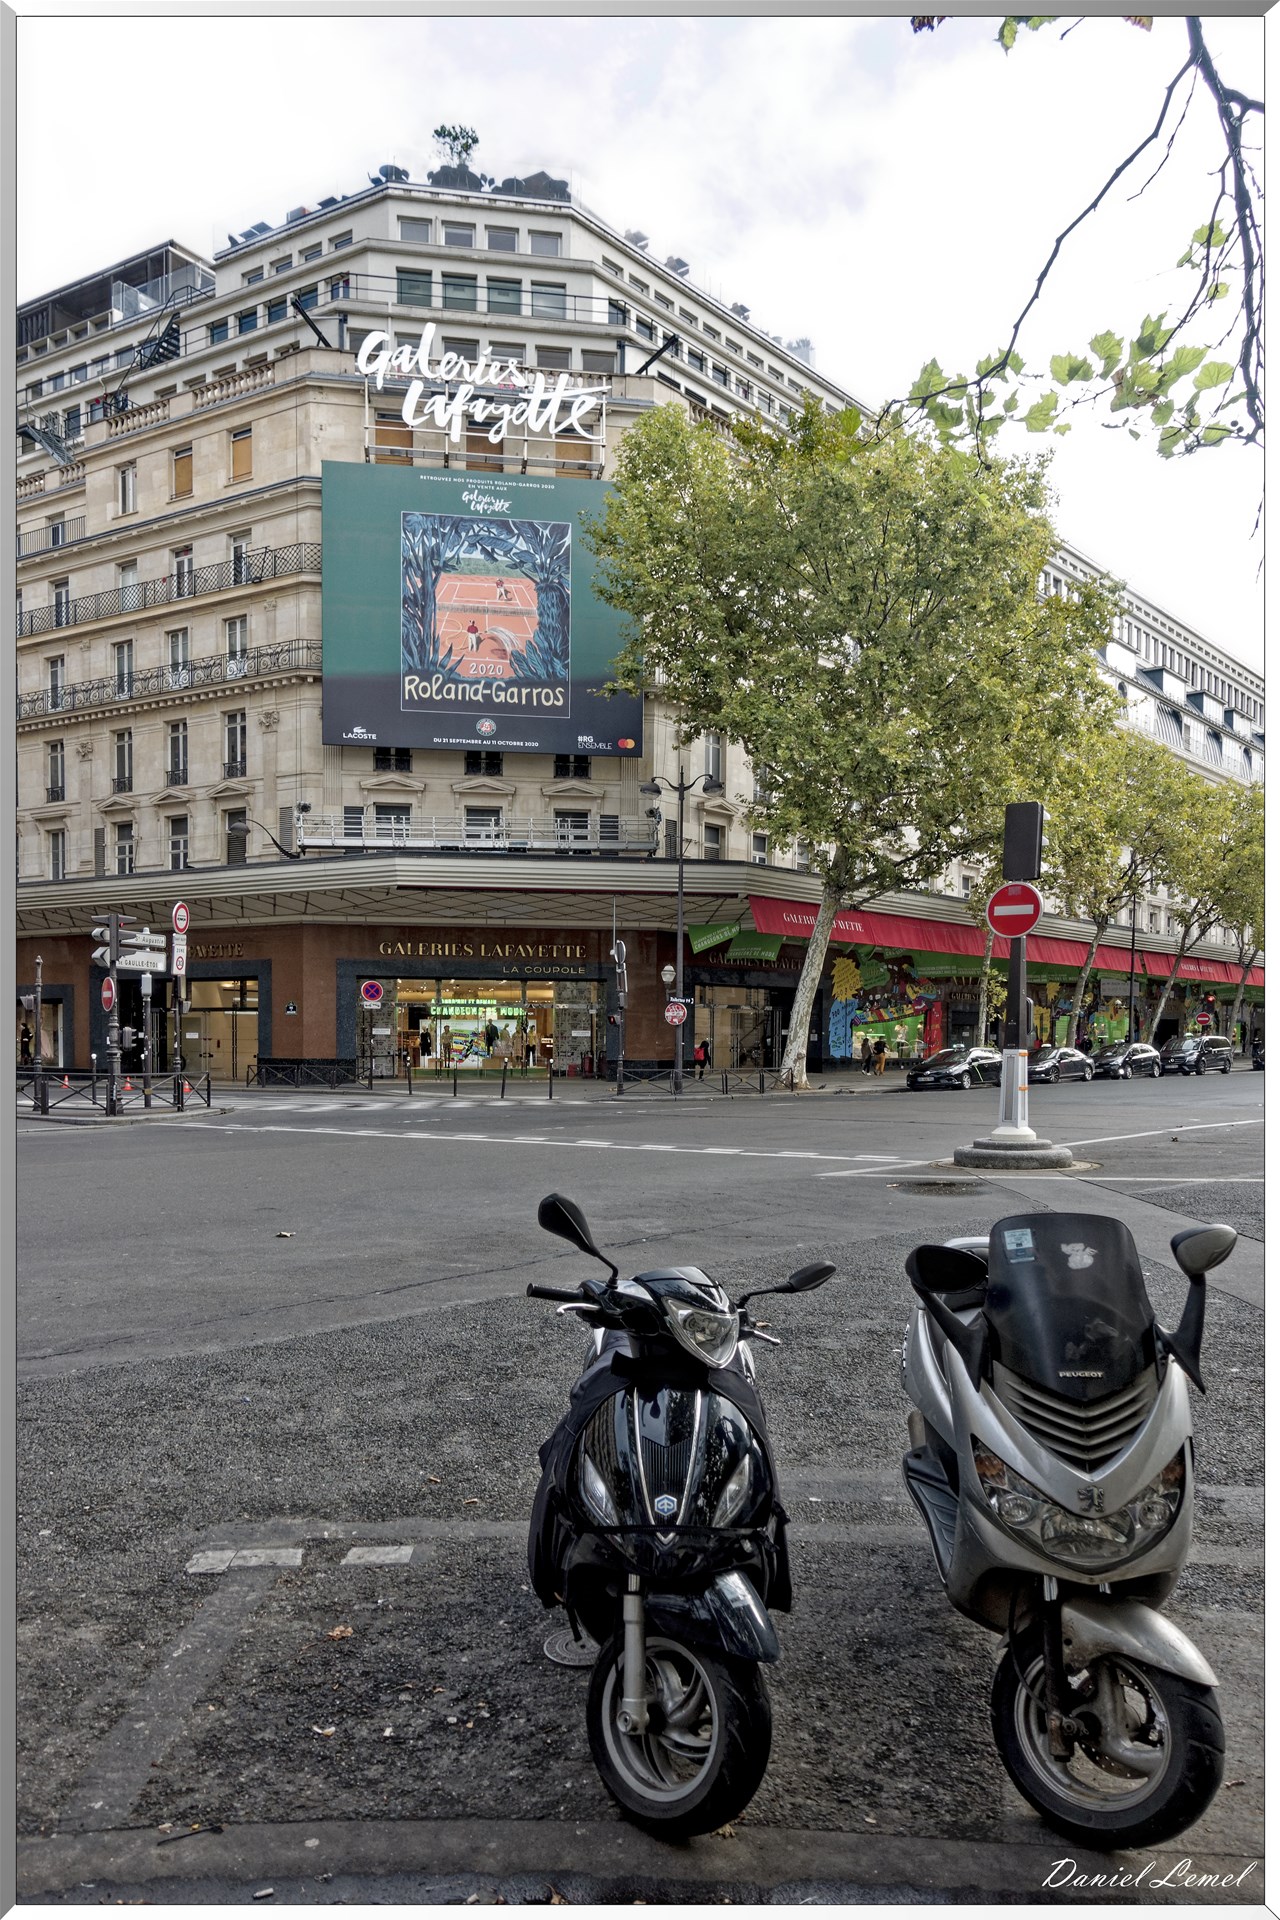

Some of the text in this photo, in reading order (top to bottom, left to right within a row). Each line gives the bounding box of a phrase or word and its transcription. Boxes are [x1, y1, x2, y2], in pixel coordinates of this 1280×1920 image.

[356, 322, 528, 390] Galeries
[402, 373, 612, 443] Lafayette
[494, 480, 540, 488] ROLAND-GARROS
[461, 489, 496, 503] Galeries
[470, 499, 513, 514] Lafayette
[469, 662, 504, 676] 2020
[404, 673, 565, 706] Roland-Garros
[342, 732, 377, 740] LACOSTE
[577, 735, 594, 743] #RG
[577, 742, 613, 750] ENSEMBLE
[783, 912, 865, 932] GALERIE FAYETTE
[187, 943, 244, 958] FAYETTE
[379, 941, 587, 958] GALERIES LAFAYETTE
[125, 958, 159, 968] GAULLE-ÉTOI
[503, 966, 586, 974] LA COUPOLE
